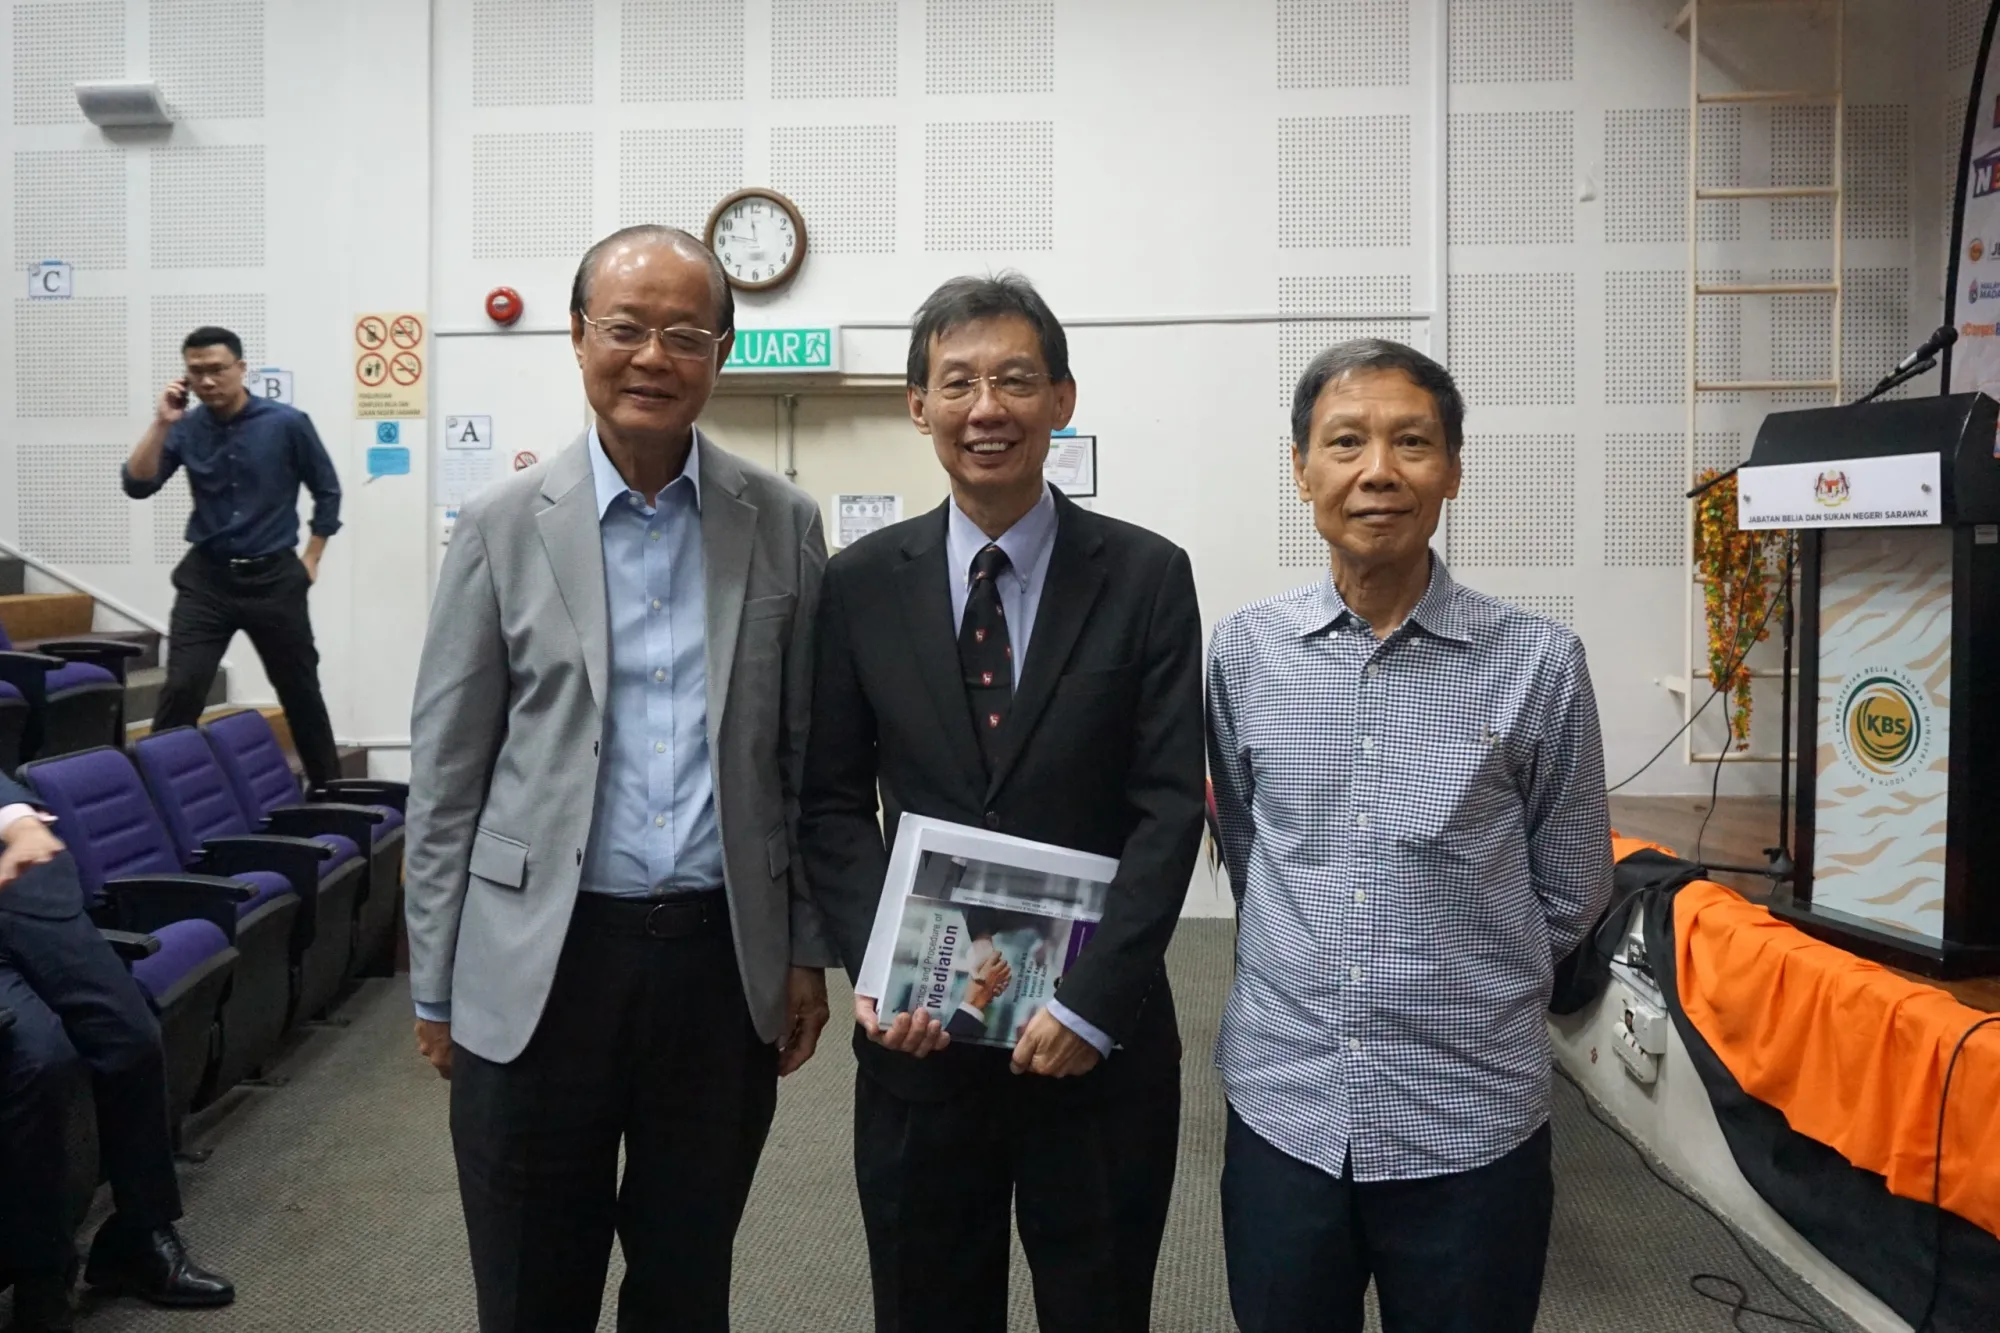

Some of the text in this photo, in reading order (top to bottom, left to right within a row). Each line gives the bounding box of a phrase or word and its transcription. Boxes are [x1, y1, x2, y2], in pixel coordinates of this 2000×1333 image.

[733, 205, 744, 219] 11
[750, 203, 761, 214] 12
[769, 204, 775, 219] 1
[721, 218, 733, 232] 10
[779, 217, 787, 231] 2
[718, 235, 726, 248] 9
[785, 234, 793, 248] 3
[723, 252, 732, 266] 8
[779, 251, 787, 265] 4
[734, 264, 742, 277] 7
[751, 268, 760, 281] 6
[767, 263, 775, 277] 5
[42, 270, 61, 293] C
[725, 332, 800, 364] LUAR
[264, 377, 282, 400] B
[459, 420, 480, 443] A
[1748, 510, 1929, 523] JABATAN BELIA DAN SUKAN NEGERI SARAWAK
[1867, 714, 1907, 738] KBS
[924, 924, 941, 965] Procedure
[926, 925, 959, 1009] Mediation
[921, 967, 931, 982] and
